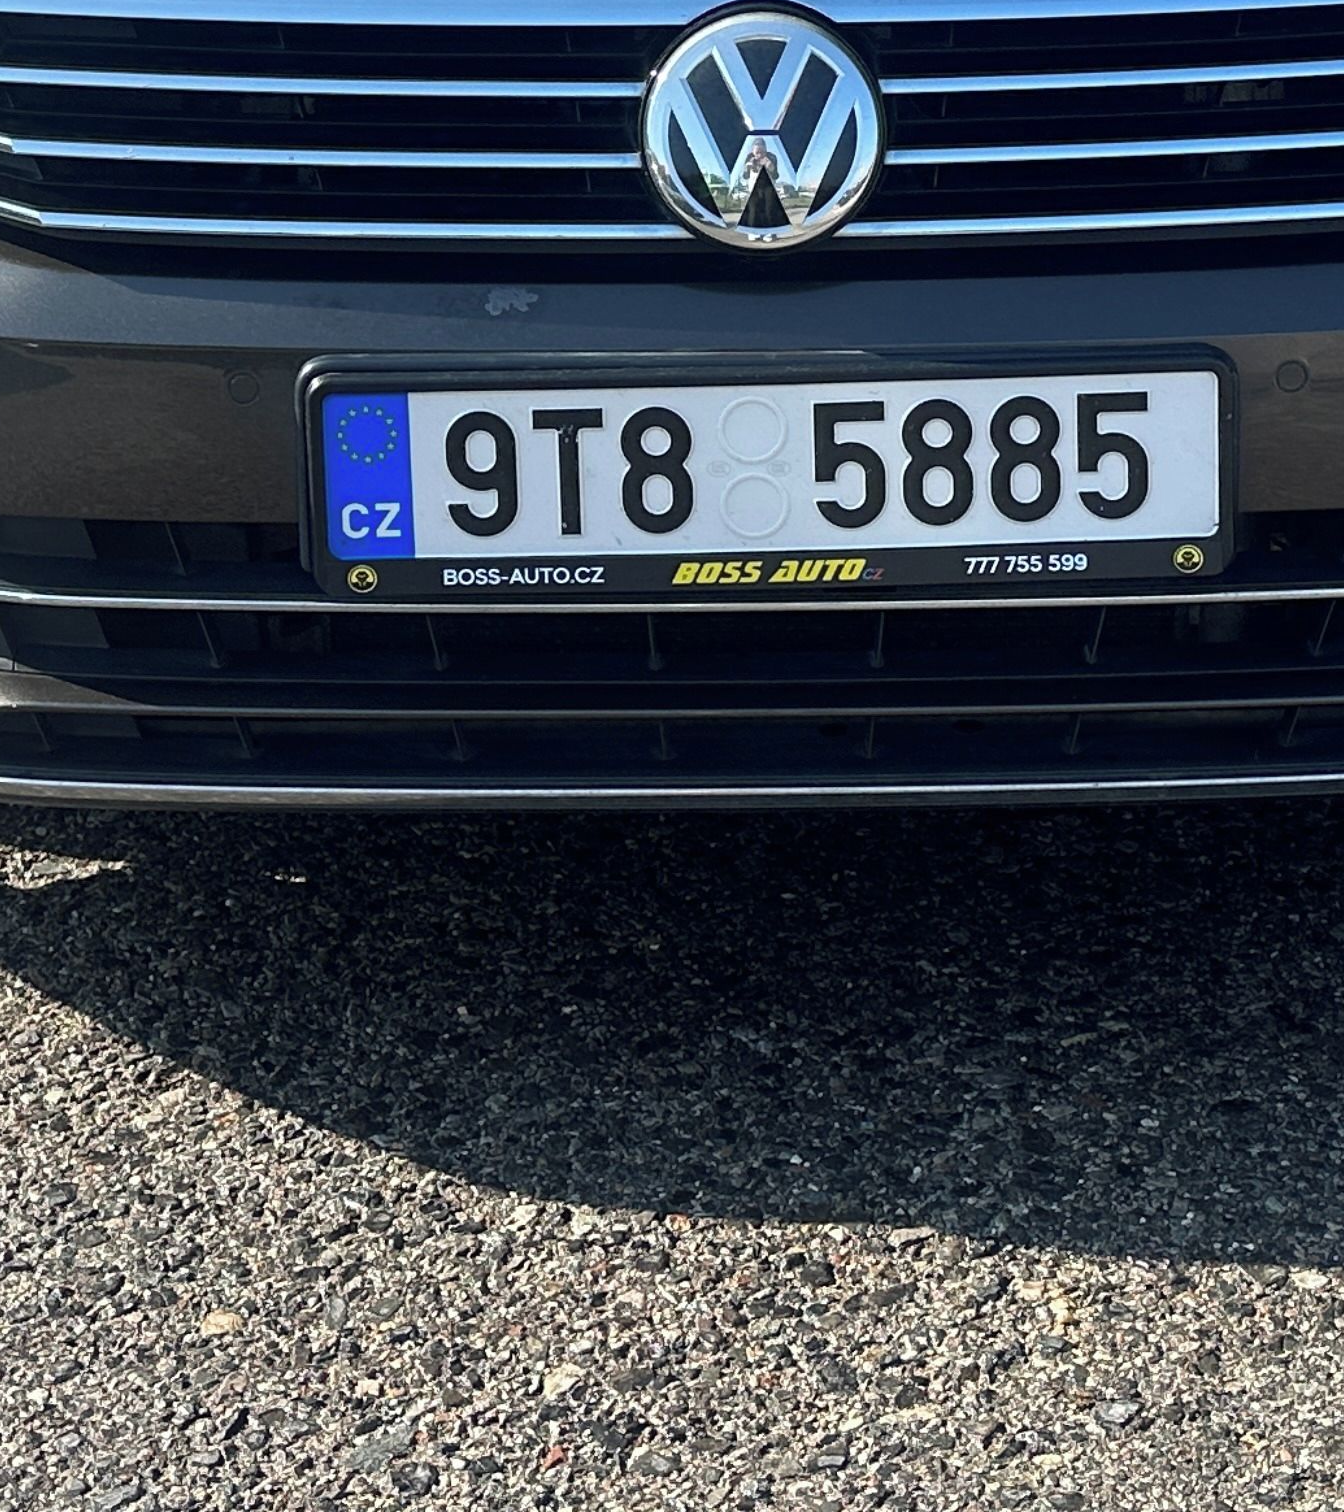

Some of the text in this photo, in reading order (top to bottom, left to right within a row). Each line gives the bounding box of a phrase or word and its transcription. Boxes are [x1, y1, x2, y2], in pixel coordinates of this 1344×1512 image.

[342, 390, 1150, 539] CZ 9T8 5885
[442, 566, 605, 586] BOSS-AUTO.CZ
[671, 561, 763, 585] BOSS
[768, 558, 867, 583] AUTO
[964, 556, 999, 575] 777
[1004, 555, 1043, 573] 755
[1048, 553, 1088, 571] 599
